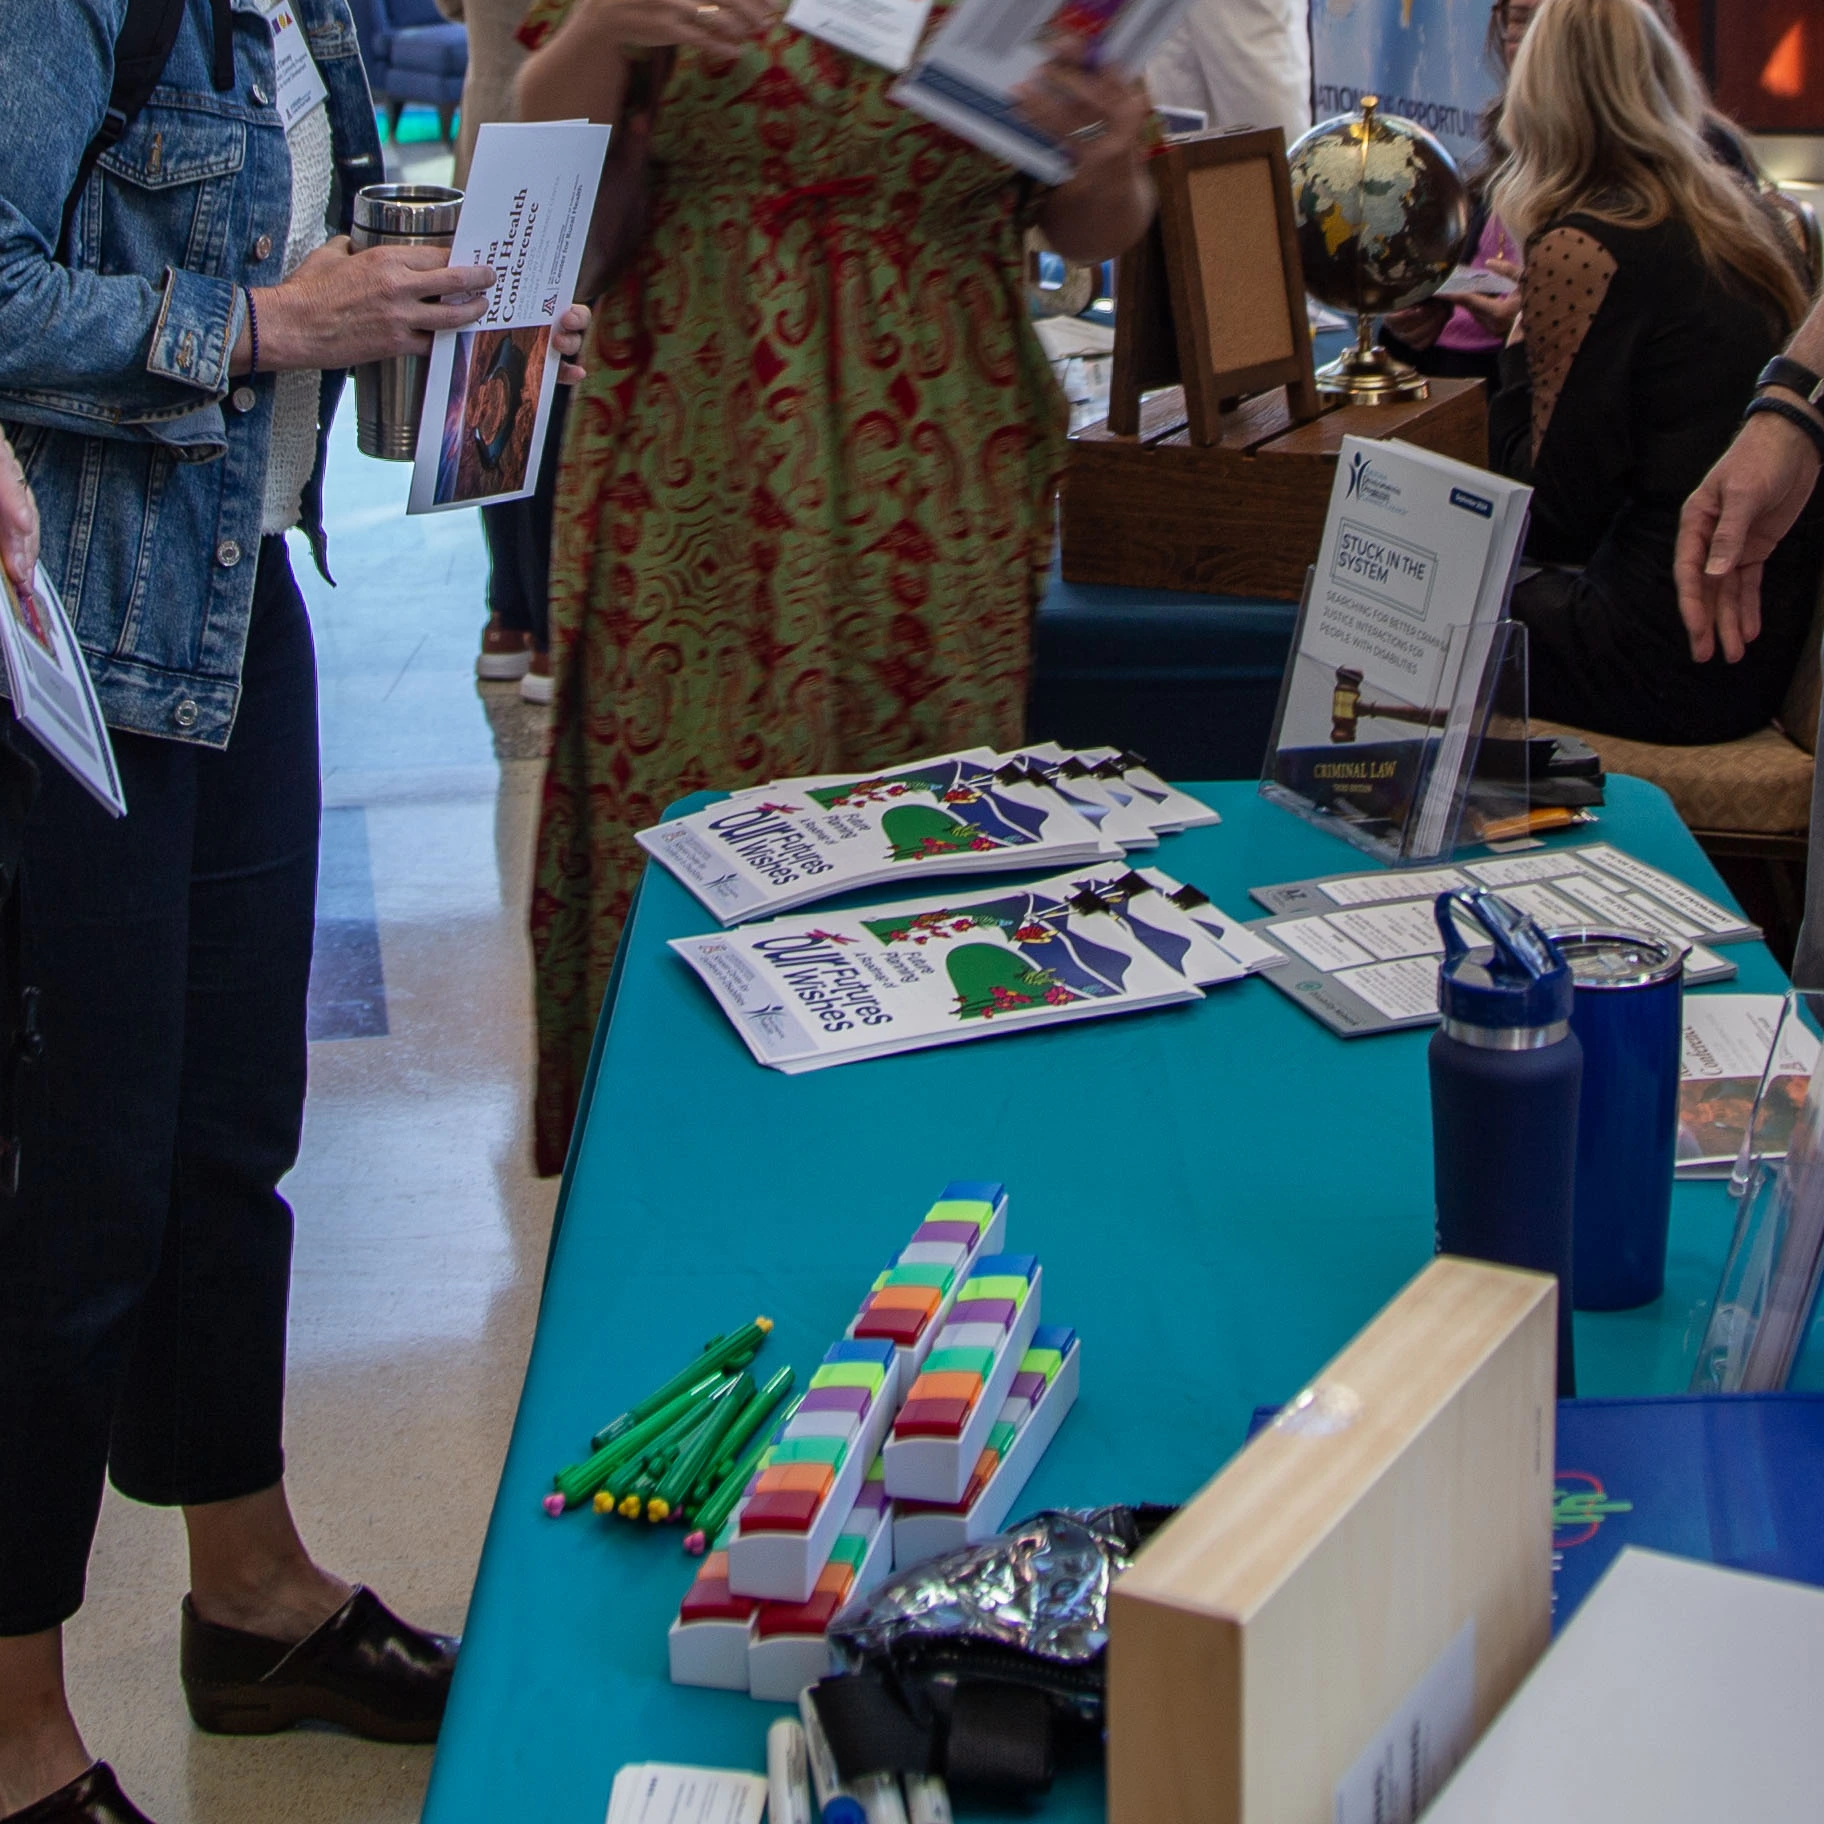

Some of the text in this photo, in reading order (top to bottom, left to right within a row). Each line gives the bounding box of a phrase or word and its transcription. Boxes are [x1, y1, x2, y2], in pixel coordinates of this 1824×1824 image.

[486, 266, 508, 324] Rural
[500, 188, 528, 259] Health
[502, 202, 539, 323] Conference
[1338, 551, 1389, 584] SYSTEM
[1342, 533, 1426, 581] STUCK IN THE
[1320, 621, 1352, 645] PEOPLE
[1323, 606, 1354, 626] JUSTICE
[1314, 760, 1397, 778] CRIMINAL LAW
[769, 831, 833, 876] Futures
[783, 968, 854, 1032] Wishes
[820, 966, 893, 1026] Futures
